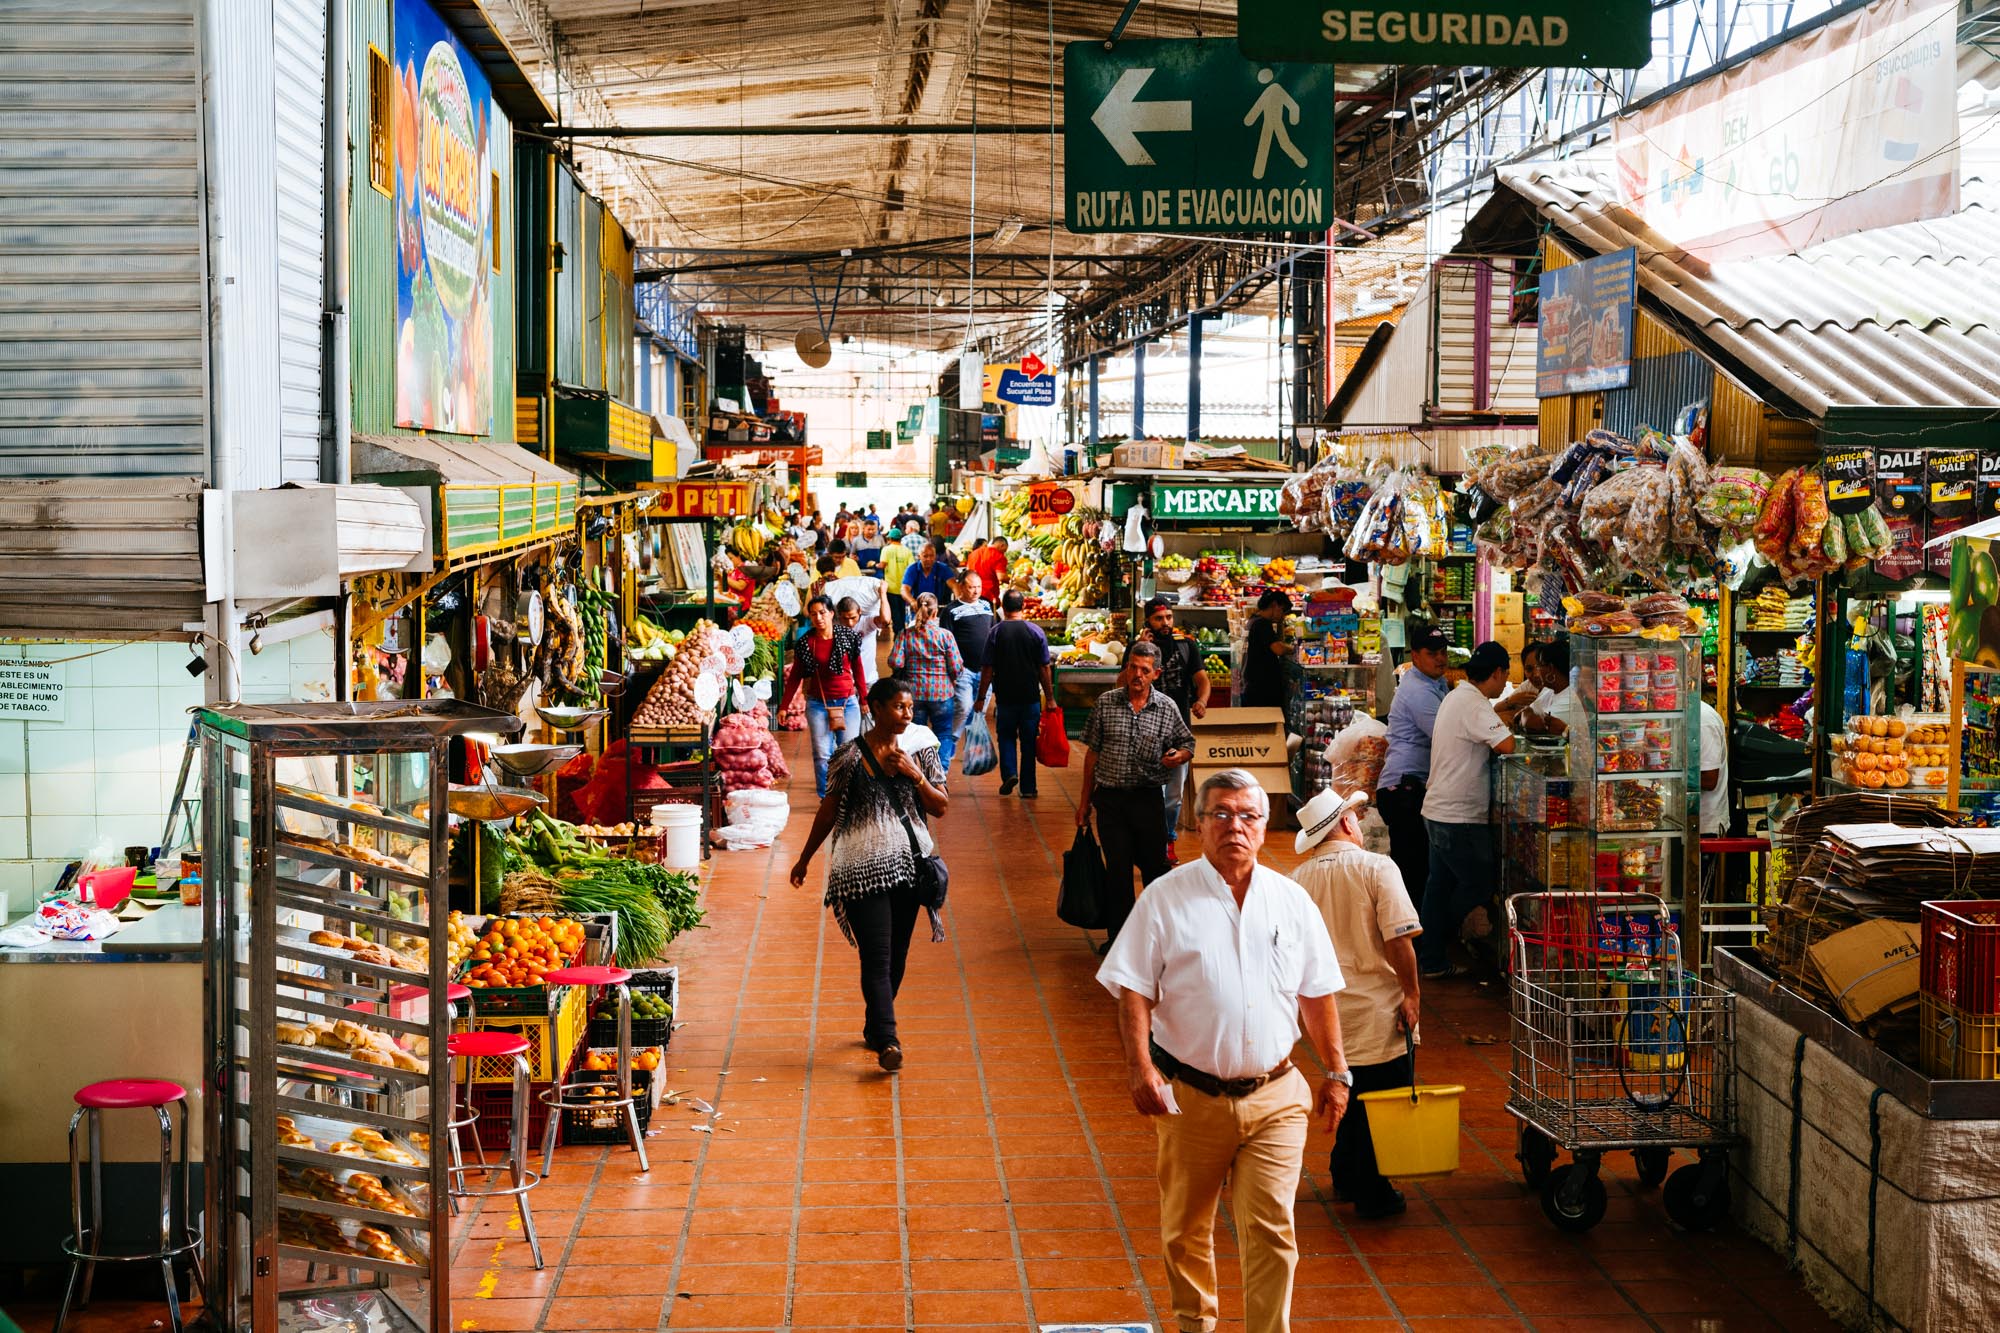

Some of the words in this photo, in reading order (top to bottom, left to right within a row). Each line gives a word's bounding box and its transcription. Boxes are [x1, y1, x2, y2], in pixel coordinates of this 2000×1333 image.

[1321, 10, 1569, 47] SEGURIDAD
[422, 100, 441, 210] LOS
[1077, 190, 1136, 227] RUTA
[1144, 190, 1172, 226] DE
[1178, 180, 1323, 226] EVACUACIÓN
[1836, 459, 1862, 470] DALE
[1880, 451, 1922, 469] DALE
[1940, 462, 1965, 473] DALE
[1836, 480, 1861, 494] Chiclets
[1938, 483, 1964, 496] Chiclets
[0, 671, 21, 679] ESTE
[37, 672, 49, 680] UN
[33, 693, 58, 701] HUMO
[12, 703, 50, 712] TABACO.
